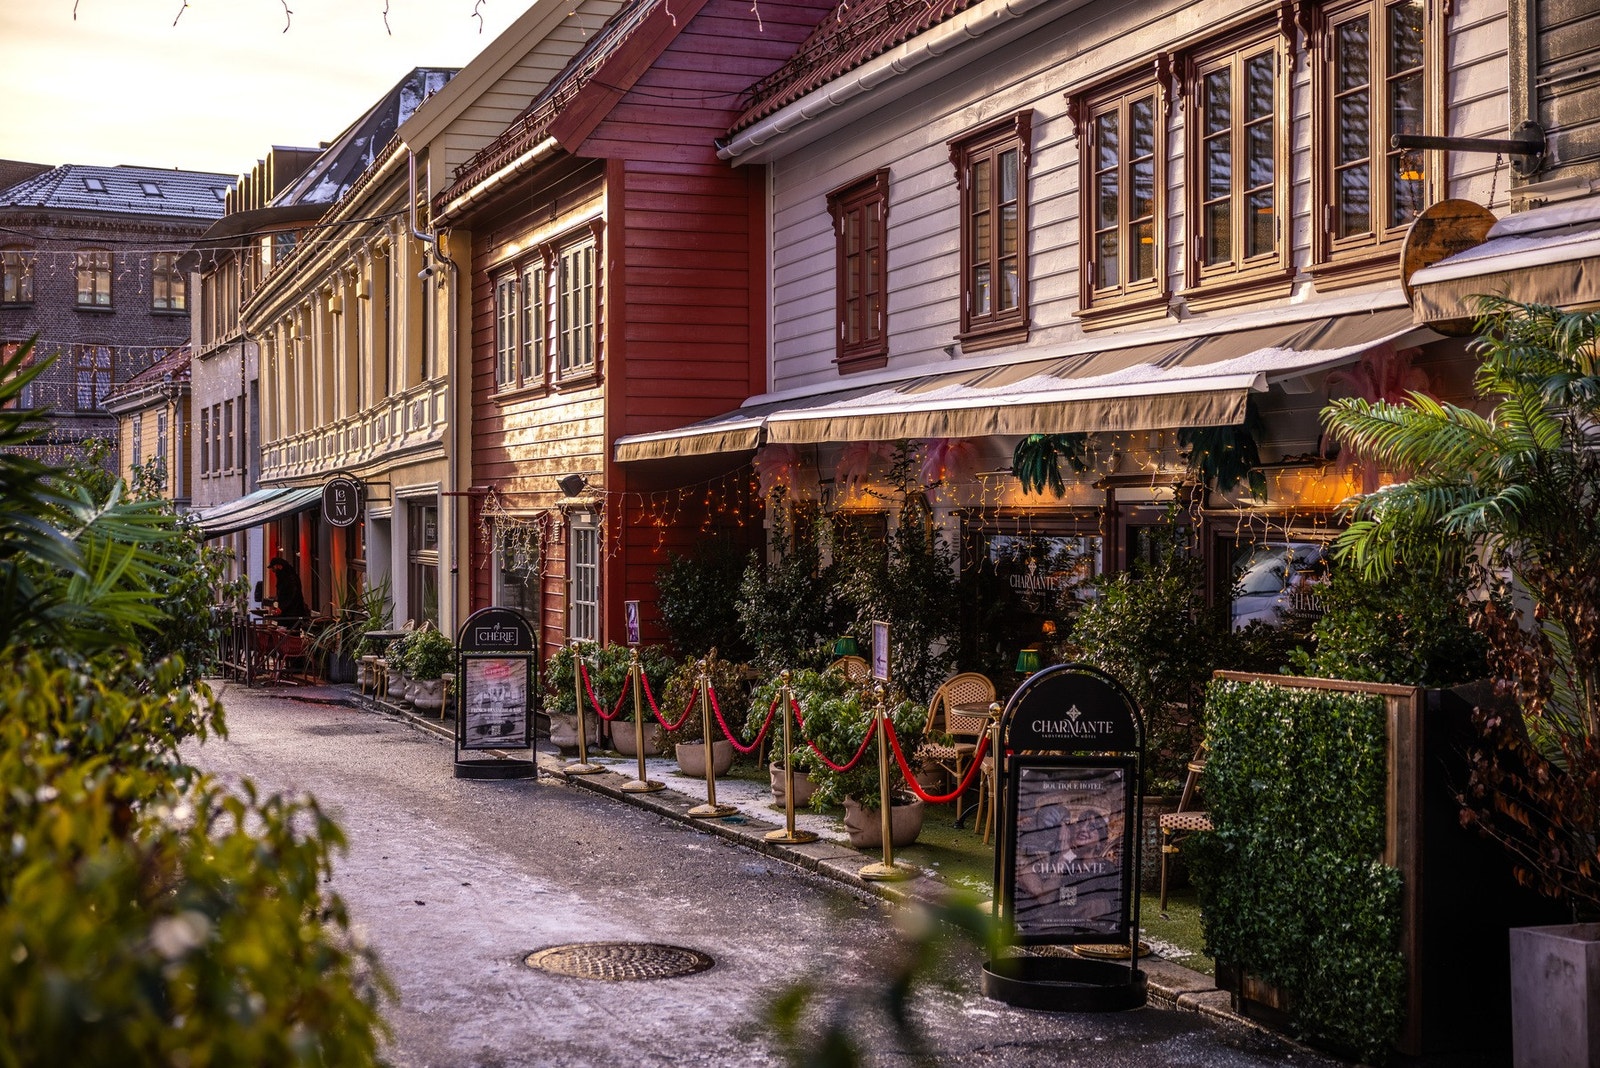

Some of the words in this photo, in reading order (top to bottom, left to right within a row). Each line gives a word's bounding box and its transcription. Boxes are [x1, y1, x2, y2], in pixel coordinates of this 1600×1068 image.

[335, 505, 347, 516] M
[1009, 573, 1056, 594] CHARMANTE
[479, 630, 515, 643] CHÉRIE
[1031, 718, 1114, 738] CHARMANTE
[1042, 781, 1079, 791] BOUTIQUE
[1032, 861, 1106, 876] CHARMANTE
